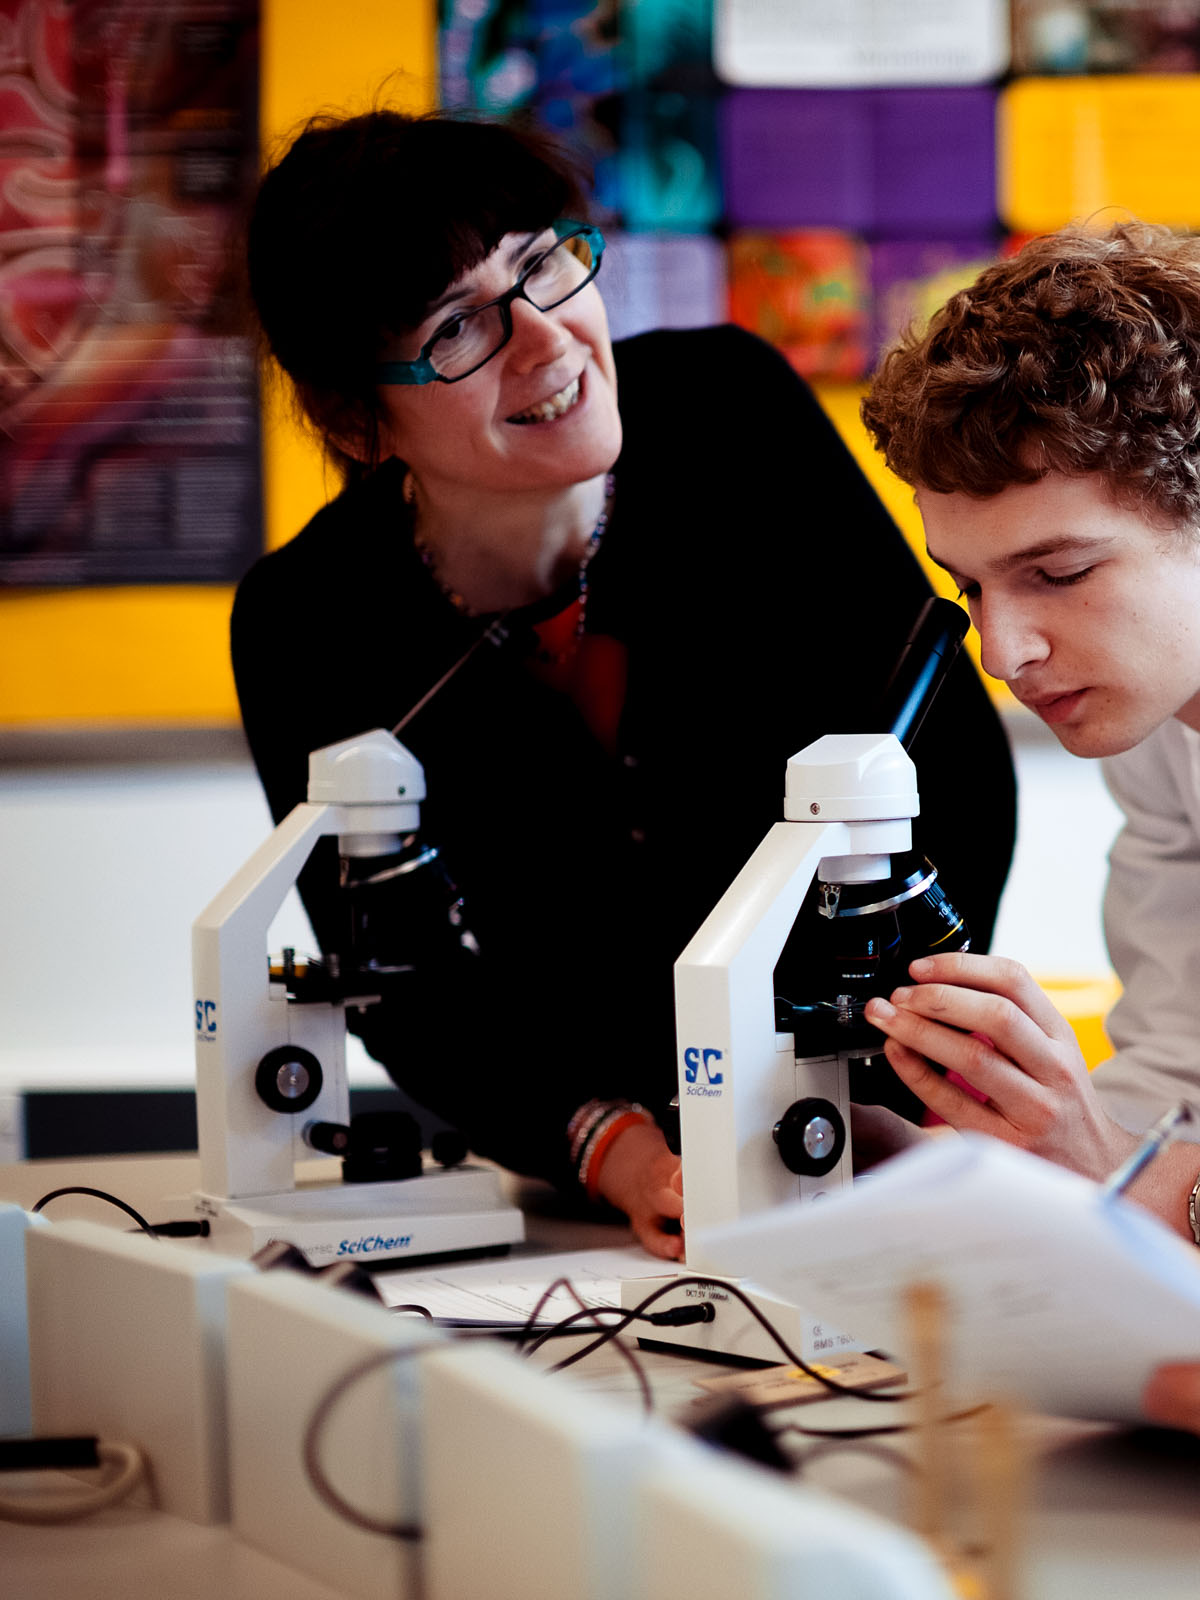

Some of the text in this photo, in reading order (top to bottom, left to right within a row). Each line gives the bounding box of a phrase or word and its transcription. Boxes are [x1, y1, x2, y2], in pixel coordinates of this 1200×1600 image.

[684, 1047, 724, 1085] SC
[686, 1086, 723, 1097] SciChem
[336, 1235, 411, 1256] SciChem
